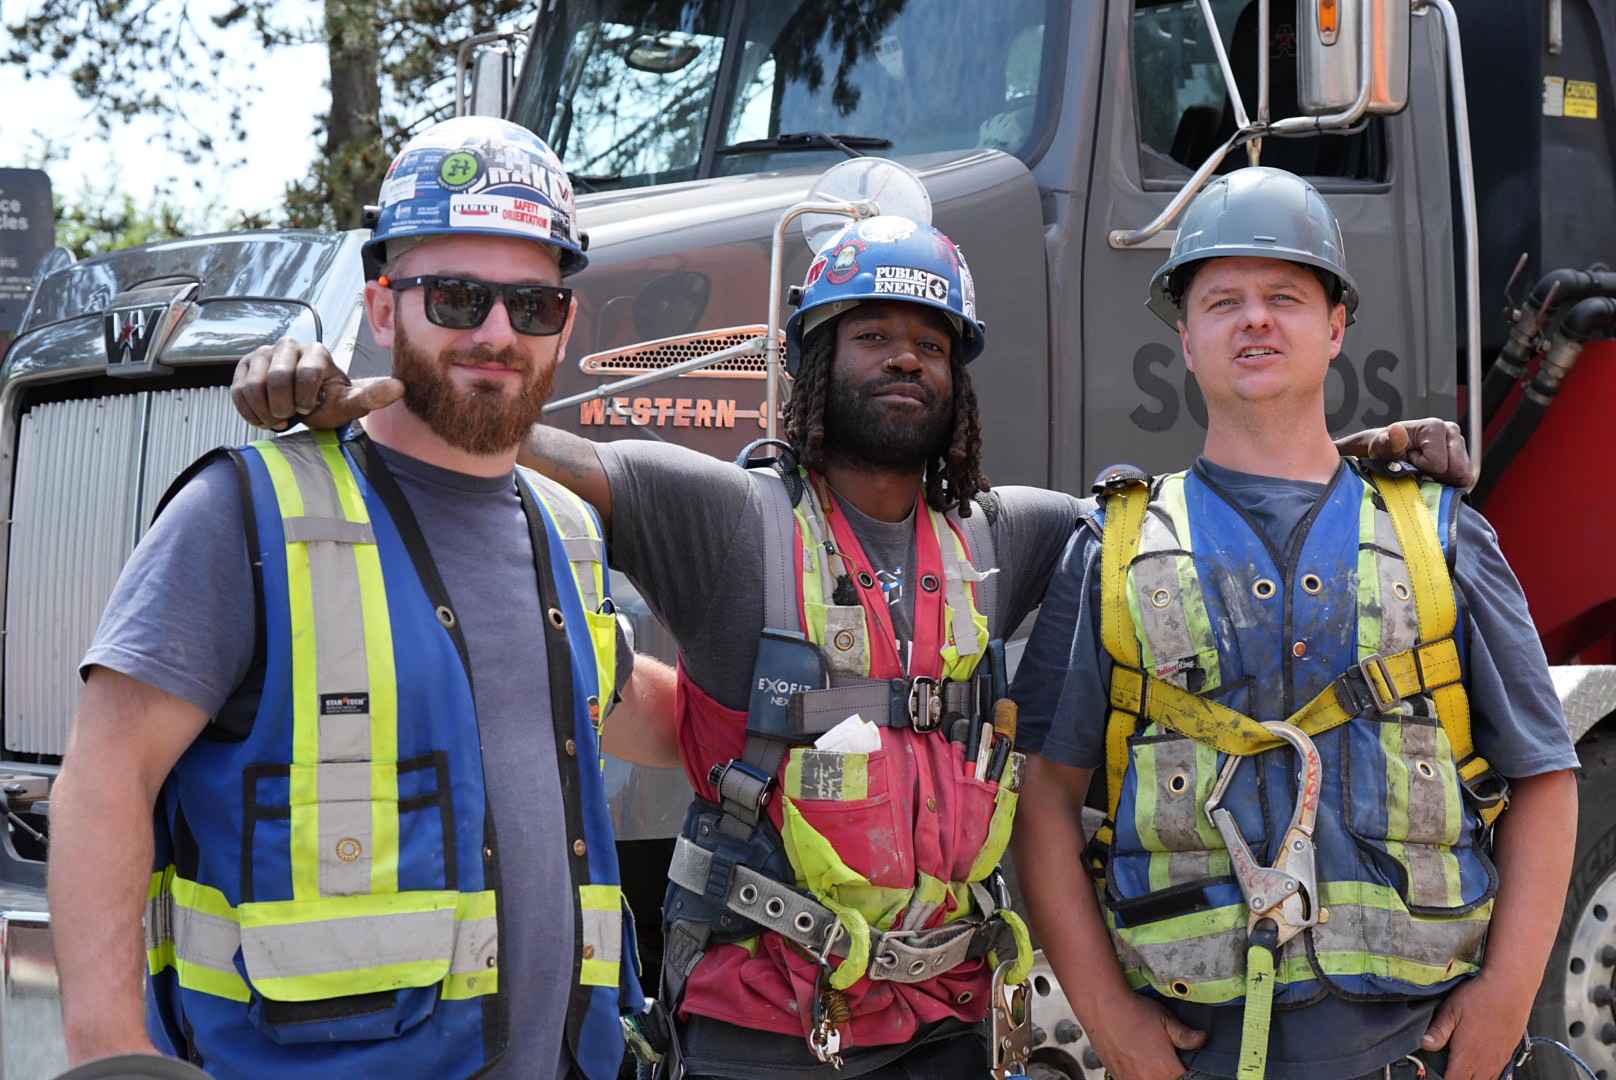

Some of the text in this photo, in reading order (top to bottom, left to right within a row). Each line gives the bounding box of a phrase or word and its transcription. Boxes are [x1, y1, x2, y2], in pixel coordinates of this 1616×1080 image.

[453, 203, 499, 213] CLUTCH
[513, 199, 540, 214] SAFETY
[502, 208, 548, 229] ORIENTATION
[876, 266, 926, 282] PUBLIC
[874, 282, 926, 297] ENEMY
[579, 397, 737, 428] WESTERN
[758, 677, 812, 695] EXOFIT
[346, 698, 365, 706] TECH
